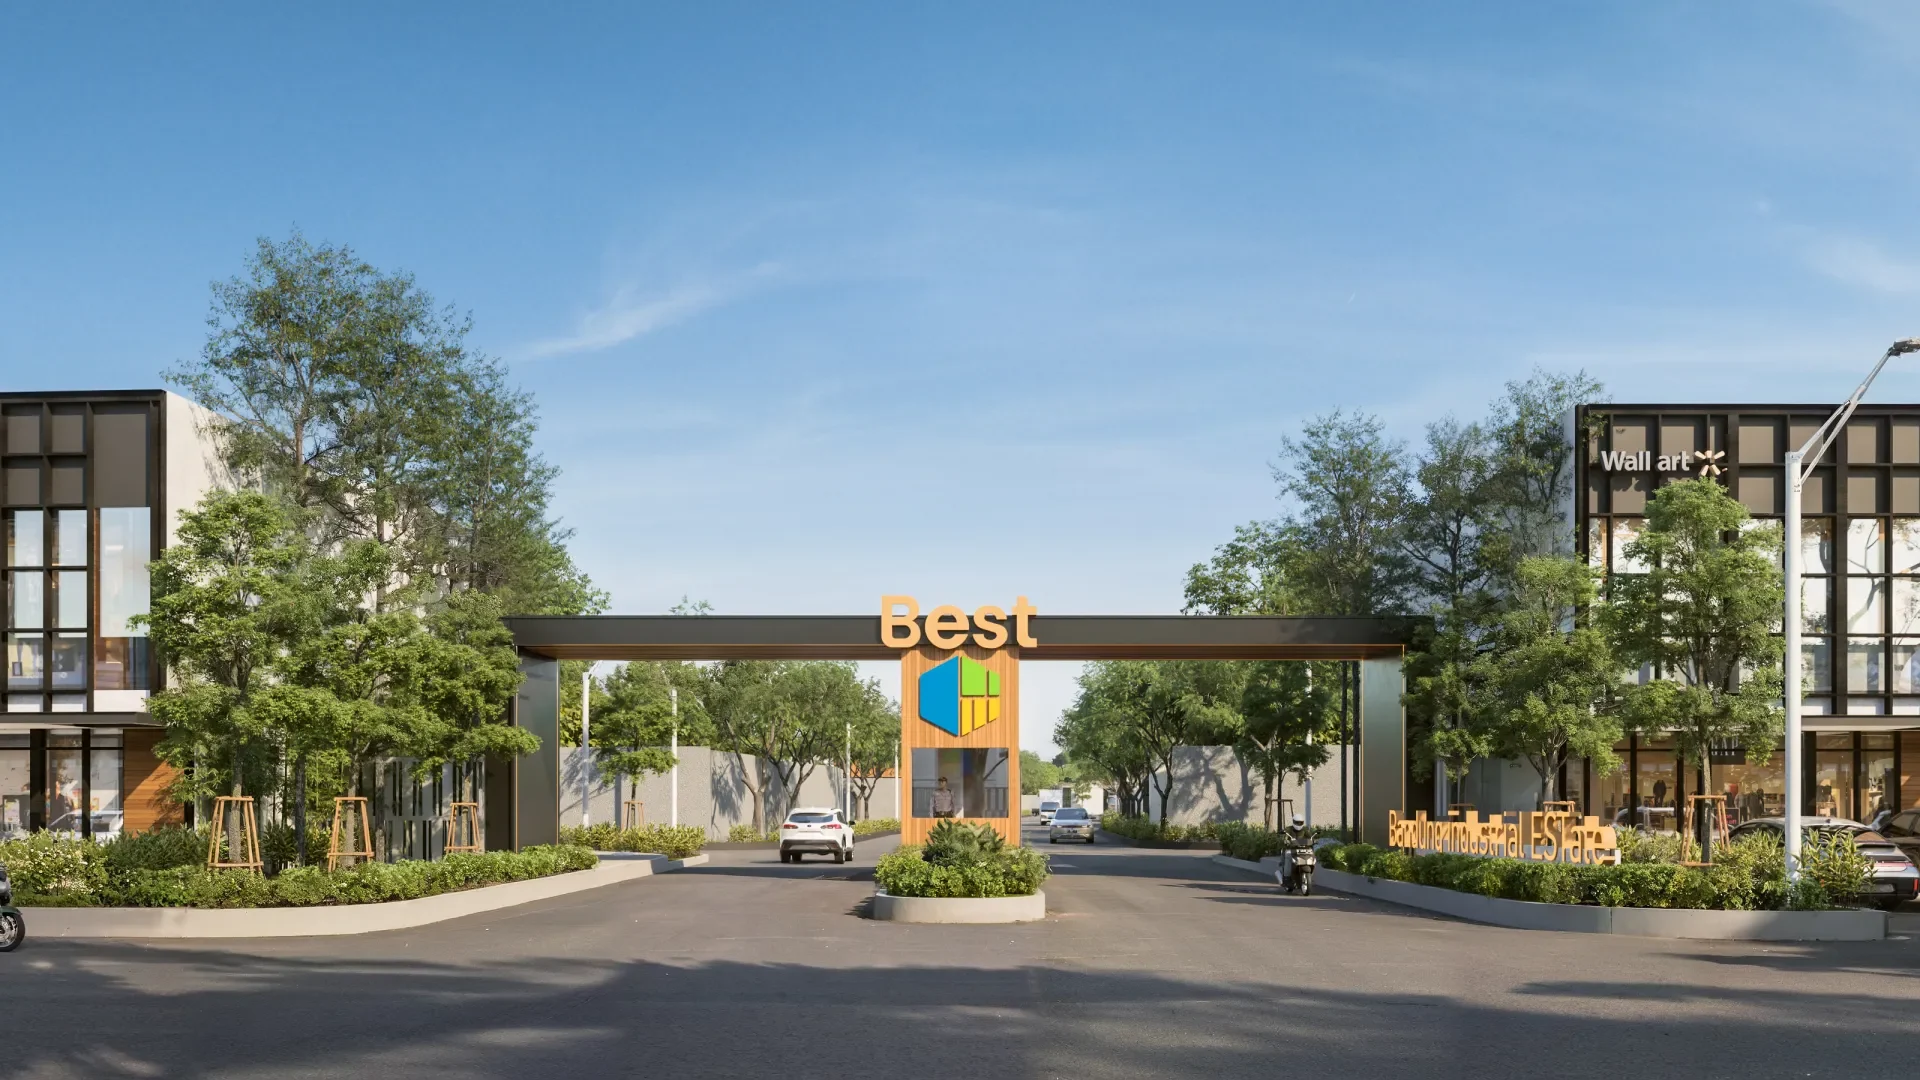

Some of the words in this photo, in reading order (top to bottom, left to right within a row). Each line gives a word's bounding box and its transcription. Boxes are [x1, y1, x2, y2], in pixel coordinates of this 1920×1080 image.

[1601, 450, 1650, 471] Wall
[1657, 450, 1690, 471] art
[881, 595, 1037, 649] Best
